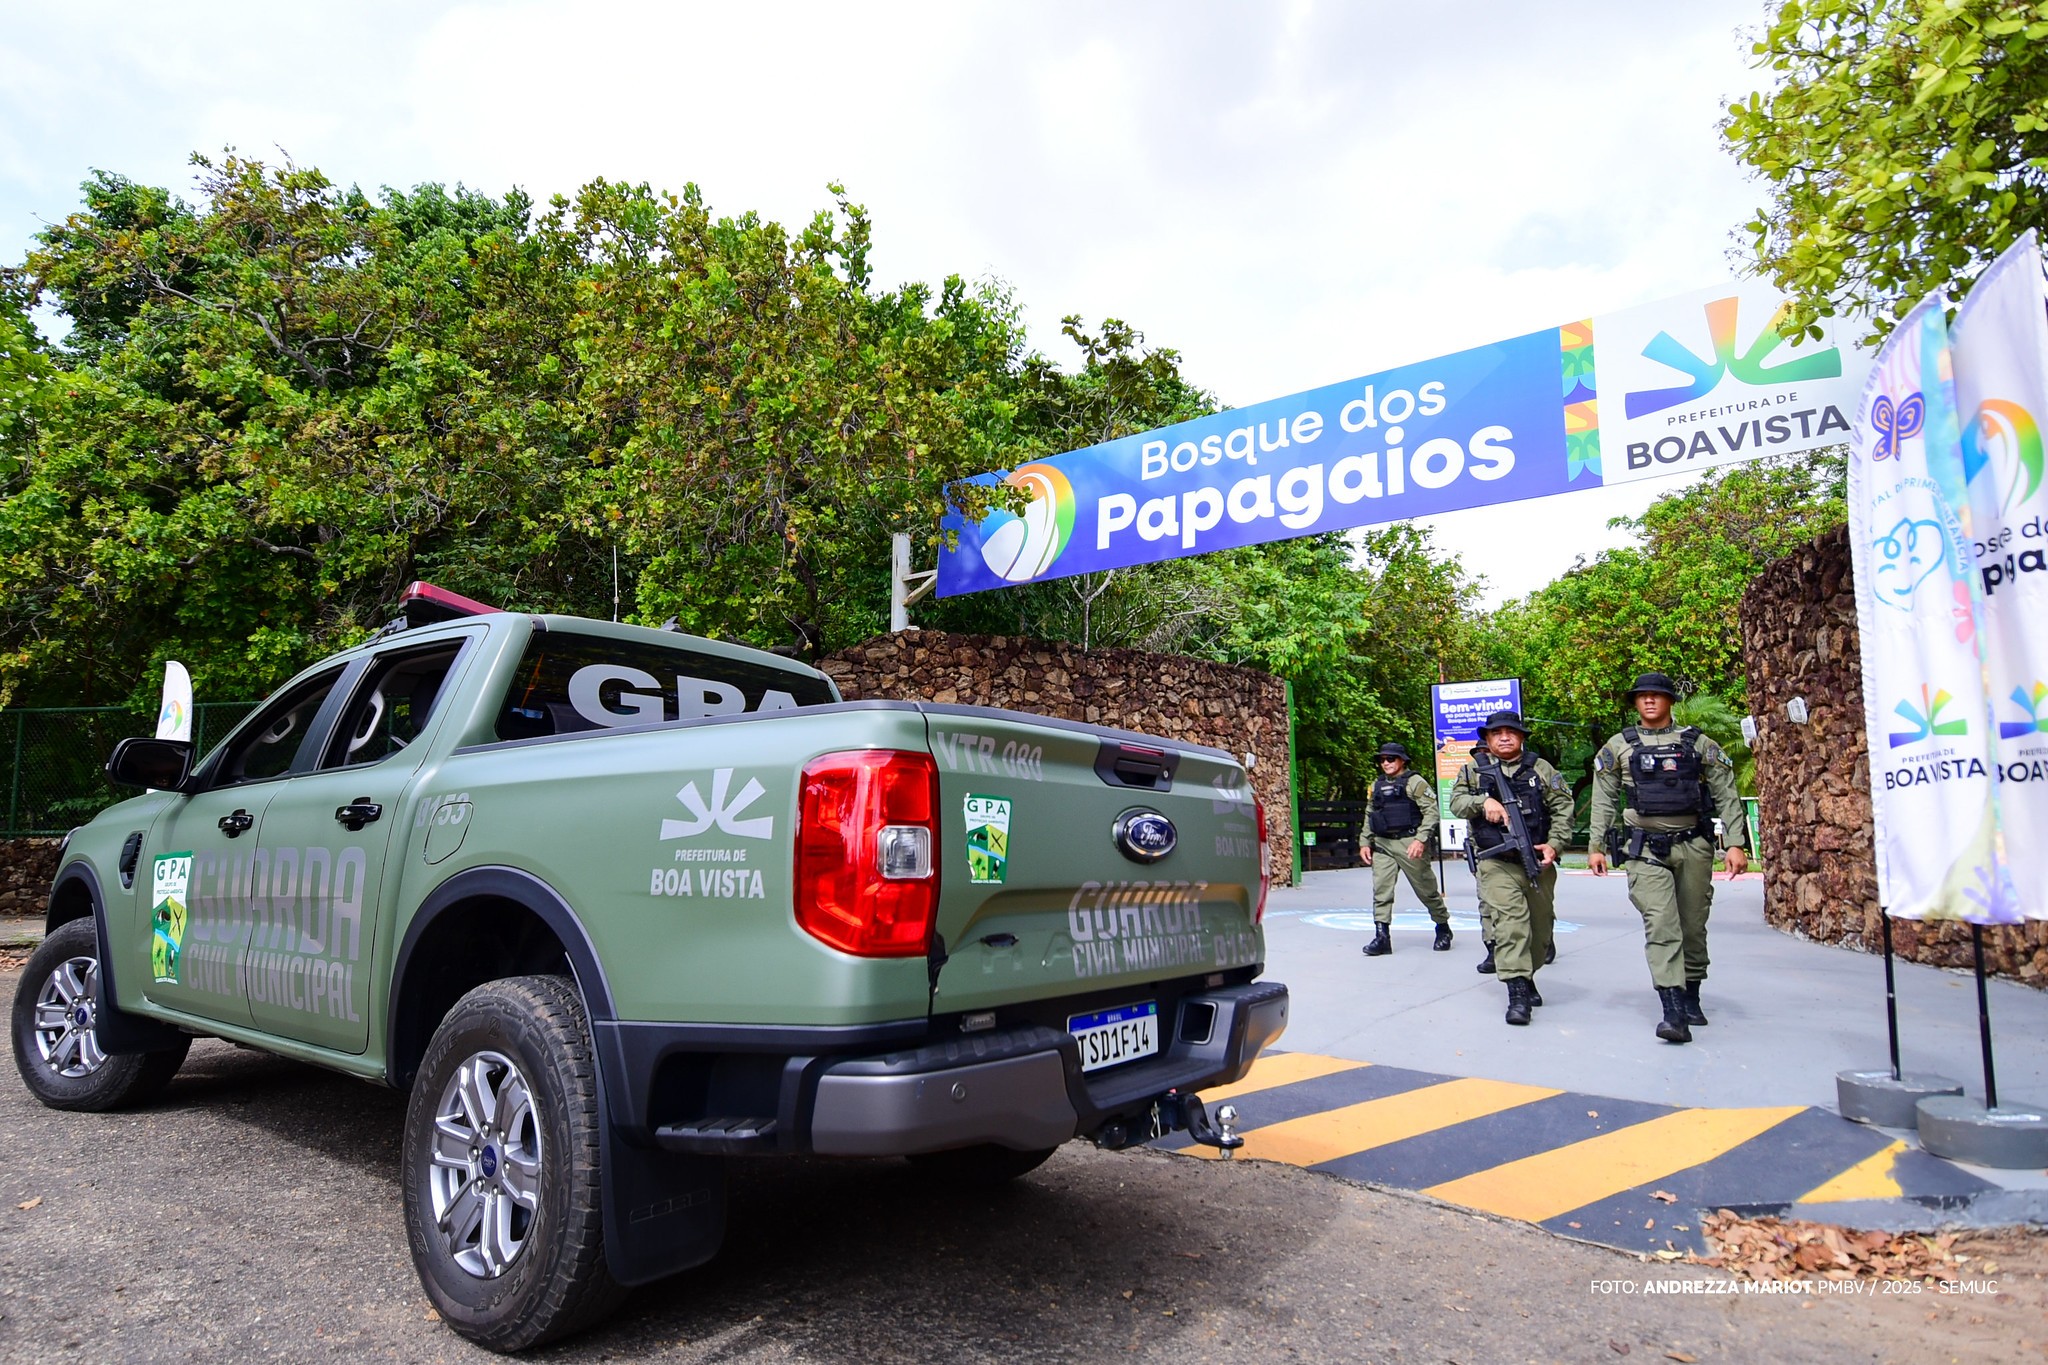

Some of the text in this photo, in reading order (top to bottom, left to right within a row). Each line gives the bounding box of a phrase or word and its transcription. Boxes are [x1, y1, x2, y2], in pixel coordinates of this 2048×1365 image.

[1141, 380, 1446, 481] Bosque dos
[1667, 391, 1799, 426] PREFEITURA DE
[1096, 425, 1516, 550] Papagaios
[1439, 698, 1513, 714] Bem-vindo
[936, 731, 1043, 782] VTR 080
[674, 848, 747, 862] PREFEITURA DE
[1140, 821, 1168, 846] Ford
[1216, 835, 1235, 857] BOA
[193, 846, 367, 961] GUARDA
[650, 868, 766, 899] BOA VISTA
[1068, 880, 1209, 942] GUARDA
[1072, 940, 1121, 978] CIVIL
[1122, 931, 1206, 972] MUNICIPAL
[187, 943, 360, 1023] CIVIL MUNICIPAL
[1077, 1020, 1149, 1067] TSD1F14
